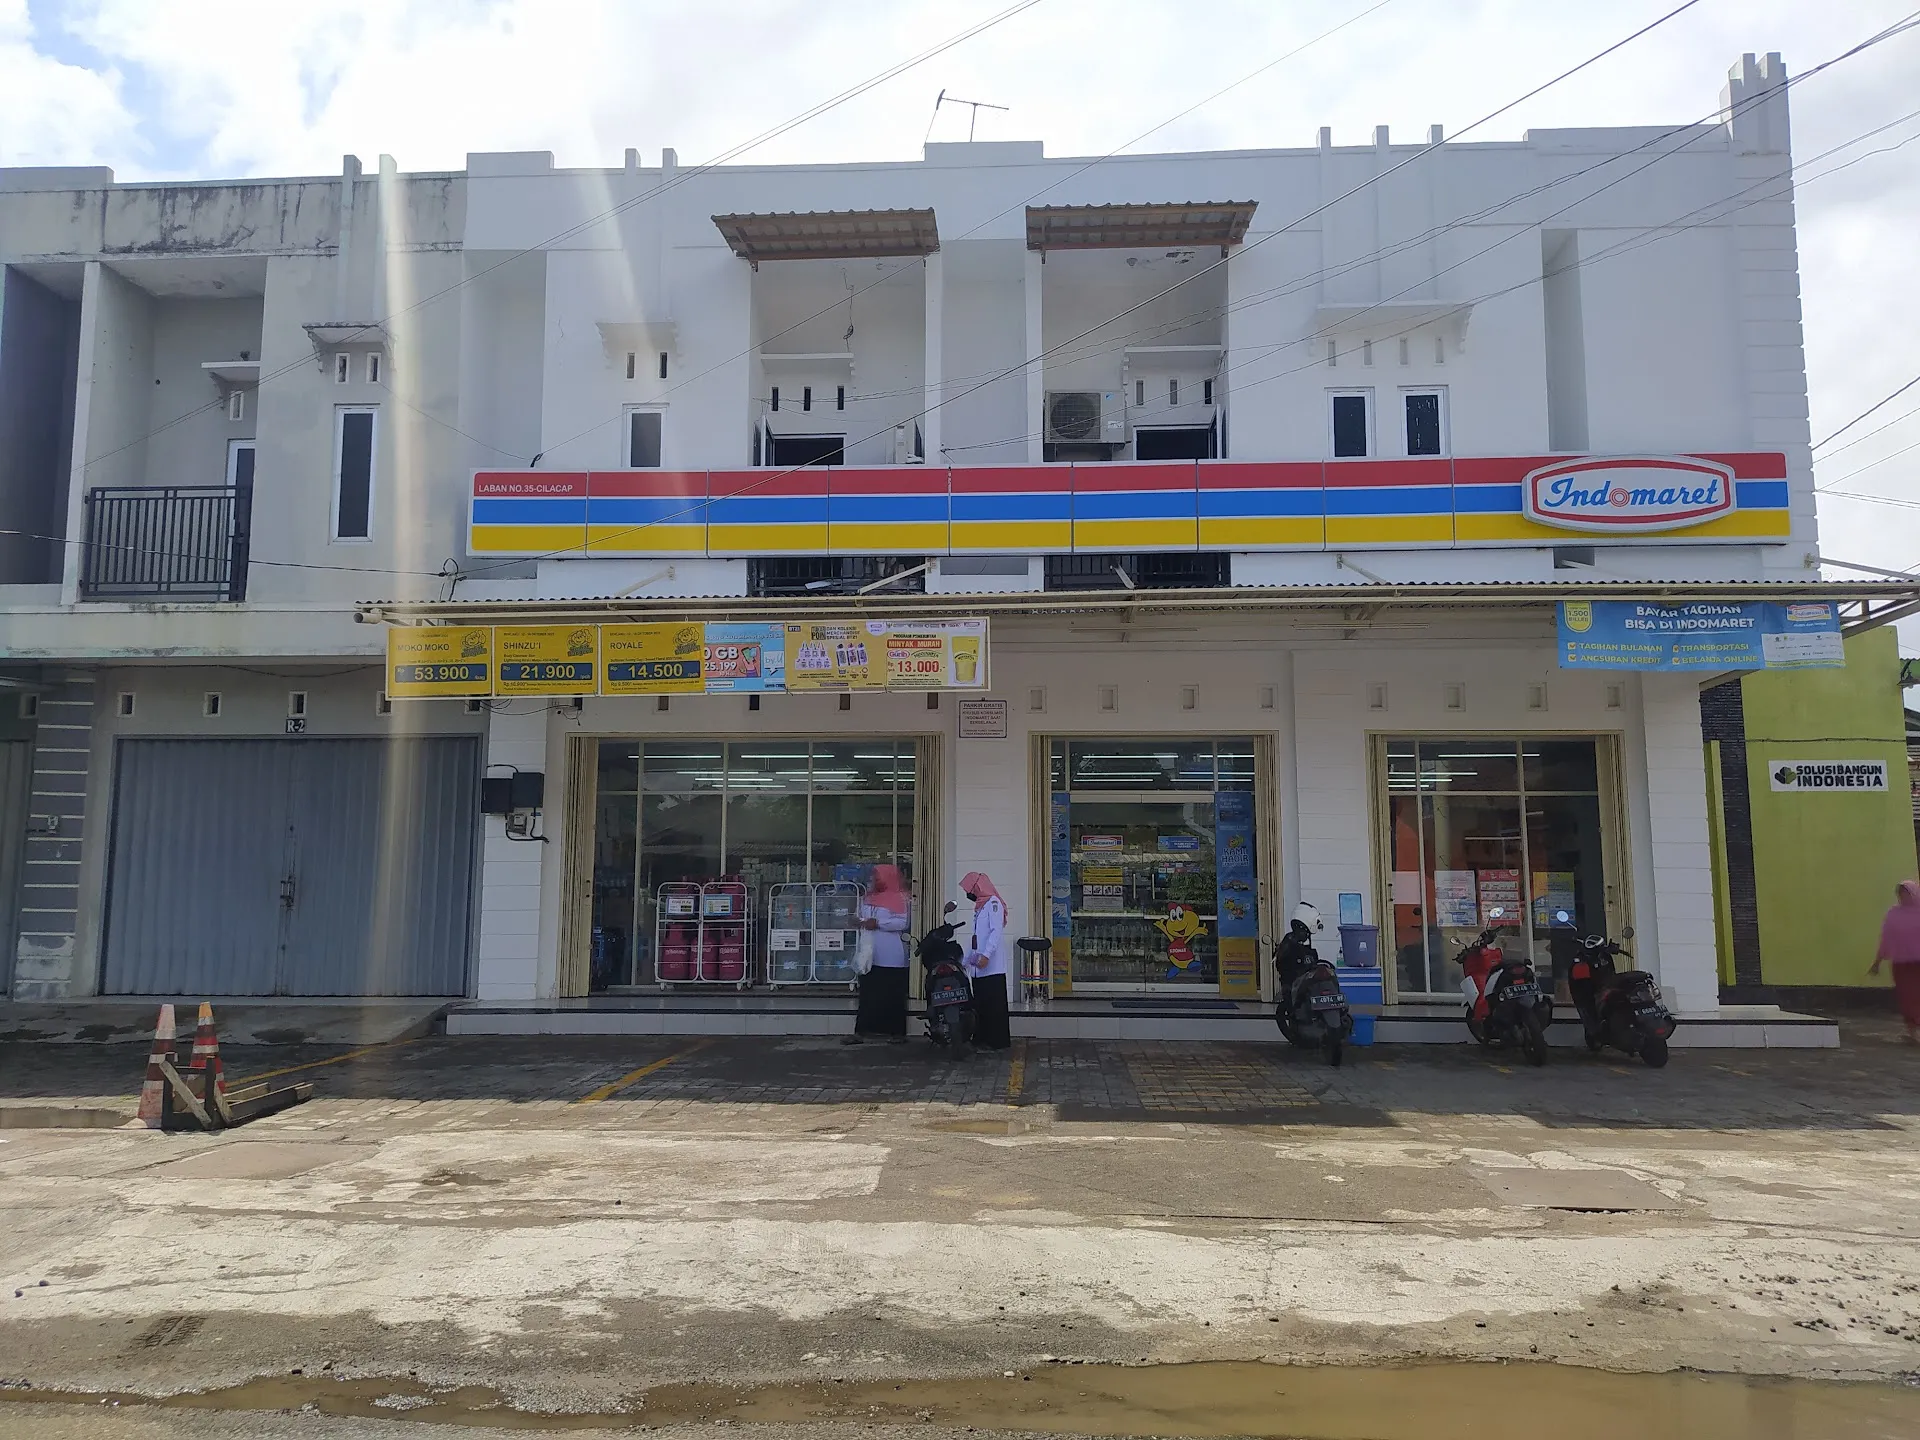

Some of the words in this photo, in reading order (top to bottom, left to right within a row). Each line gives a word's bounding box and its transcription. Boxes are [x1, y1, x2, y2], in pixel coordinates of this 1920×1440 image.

[478, 484, 507, 493] LABAN
[509, 484, 573, 493] NO.35-CILACAP
[1544, 477, 1719, 507] Indomaret
[1636, 606, 1678, 617] BAYAR
[1681, 605, 1741, 615] TAGIHAN
[1625, 619, 1656, 629] BISA
[1660, 621, 1673, 629] DI
[1677, 618, 1755, 628] INDOMARET
[424, 643, 450, 651] MOKO
[610, 642, 643, 650] ROYALE
[888, 640, 914, 648] MINYAK
[918, 640, 940, 648] MURAH
[1621, 644, 1663, 652] BULANAN
[715, 647, 738, 660] GB
[414, 666, 469, 680] 53.900
[520, 665, 576, 679] 21.900
[628, 664, 683, 678] 14.500
[287, 719, 304, 732] R-2
[1797, 775, 1883, 786] INDONESIA
